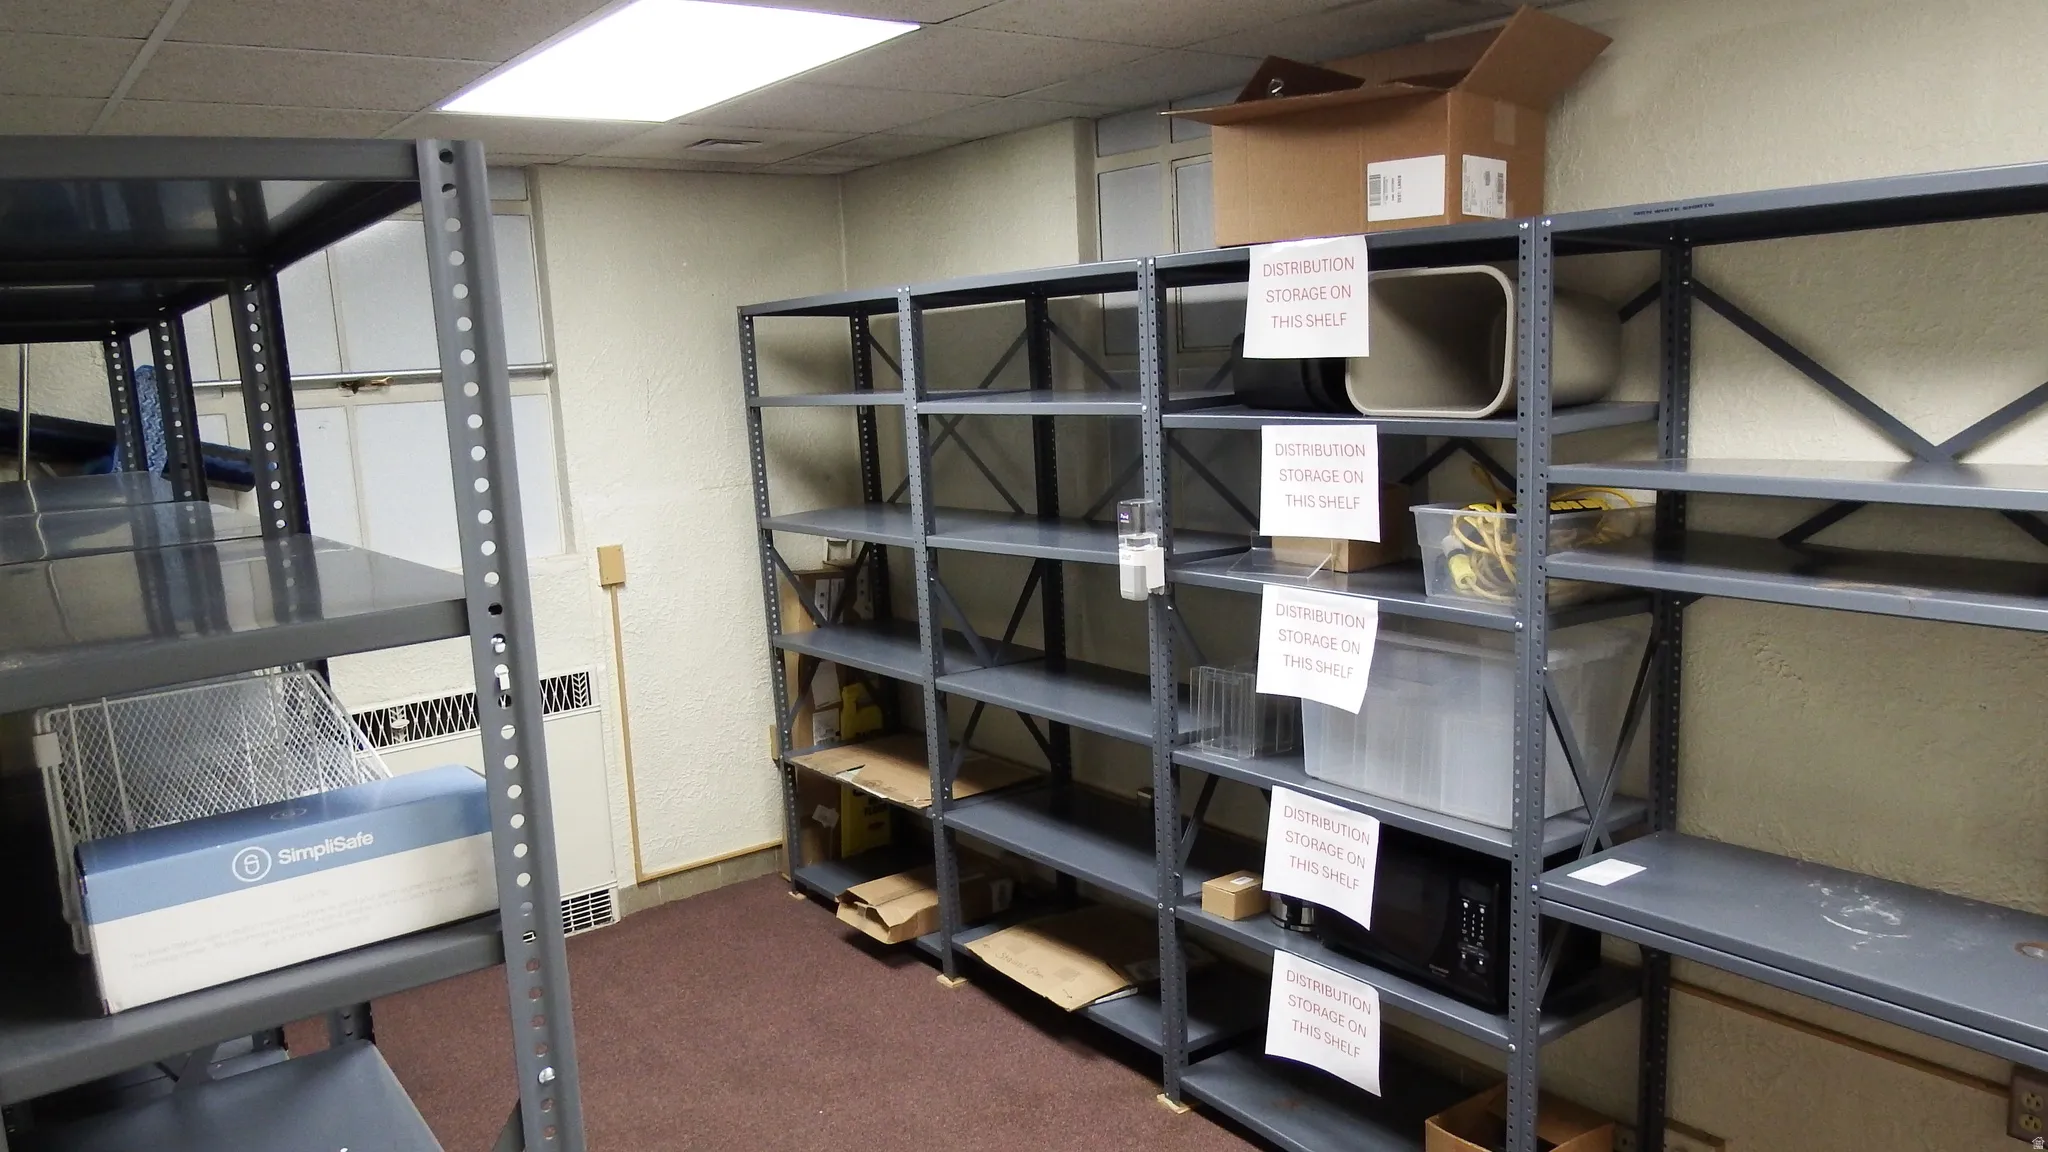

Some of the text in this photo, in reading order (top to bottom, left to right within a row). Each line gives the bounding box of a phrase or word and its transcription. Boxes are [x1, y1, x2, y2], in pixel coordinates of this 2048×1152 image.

[1263, 256, 1355, 277] DISTRIBUTION
[1265, 285, 1352, 303] STORAGE ON
[1271, 312, 1348, 329] THIS SHELF
[1275, 443, 1366, 457] DISTRIBUTION
[1279, 468, 1364, 484] STORAGE ON
[1285, 494, 1361, 510] THIS SHELF
[1276, 603, 1365, 630] DISTRIBUTION
[1278, 629, 1361, 655] STORAGE ON
[1283, 654, 1354, 680] THIS SHELF
[1284, 805, 1370, 845] DISTRIBUTION
[278, 831, 374, 865] SimpliSafe
[1285, 830, 1365, 869] STORAGE ON
[1289, 855, 1359, 892] THIS SHELF
[1286, 969, 1371, 1015] DISTRIBUTION
[1288, 994, 1367, 1038] STORAGE ON
[1292, 1019, 1360, 1058] THIS SHELF
